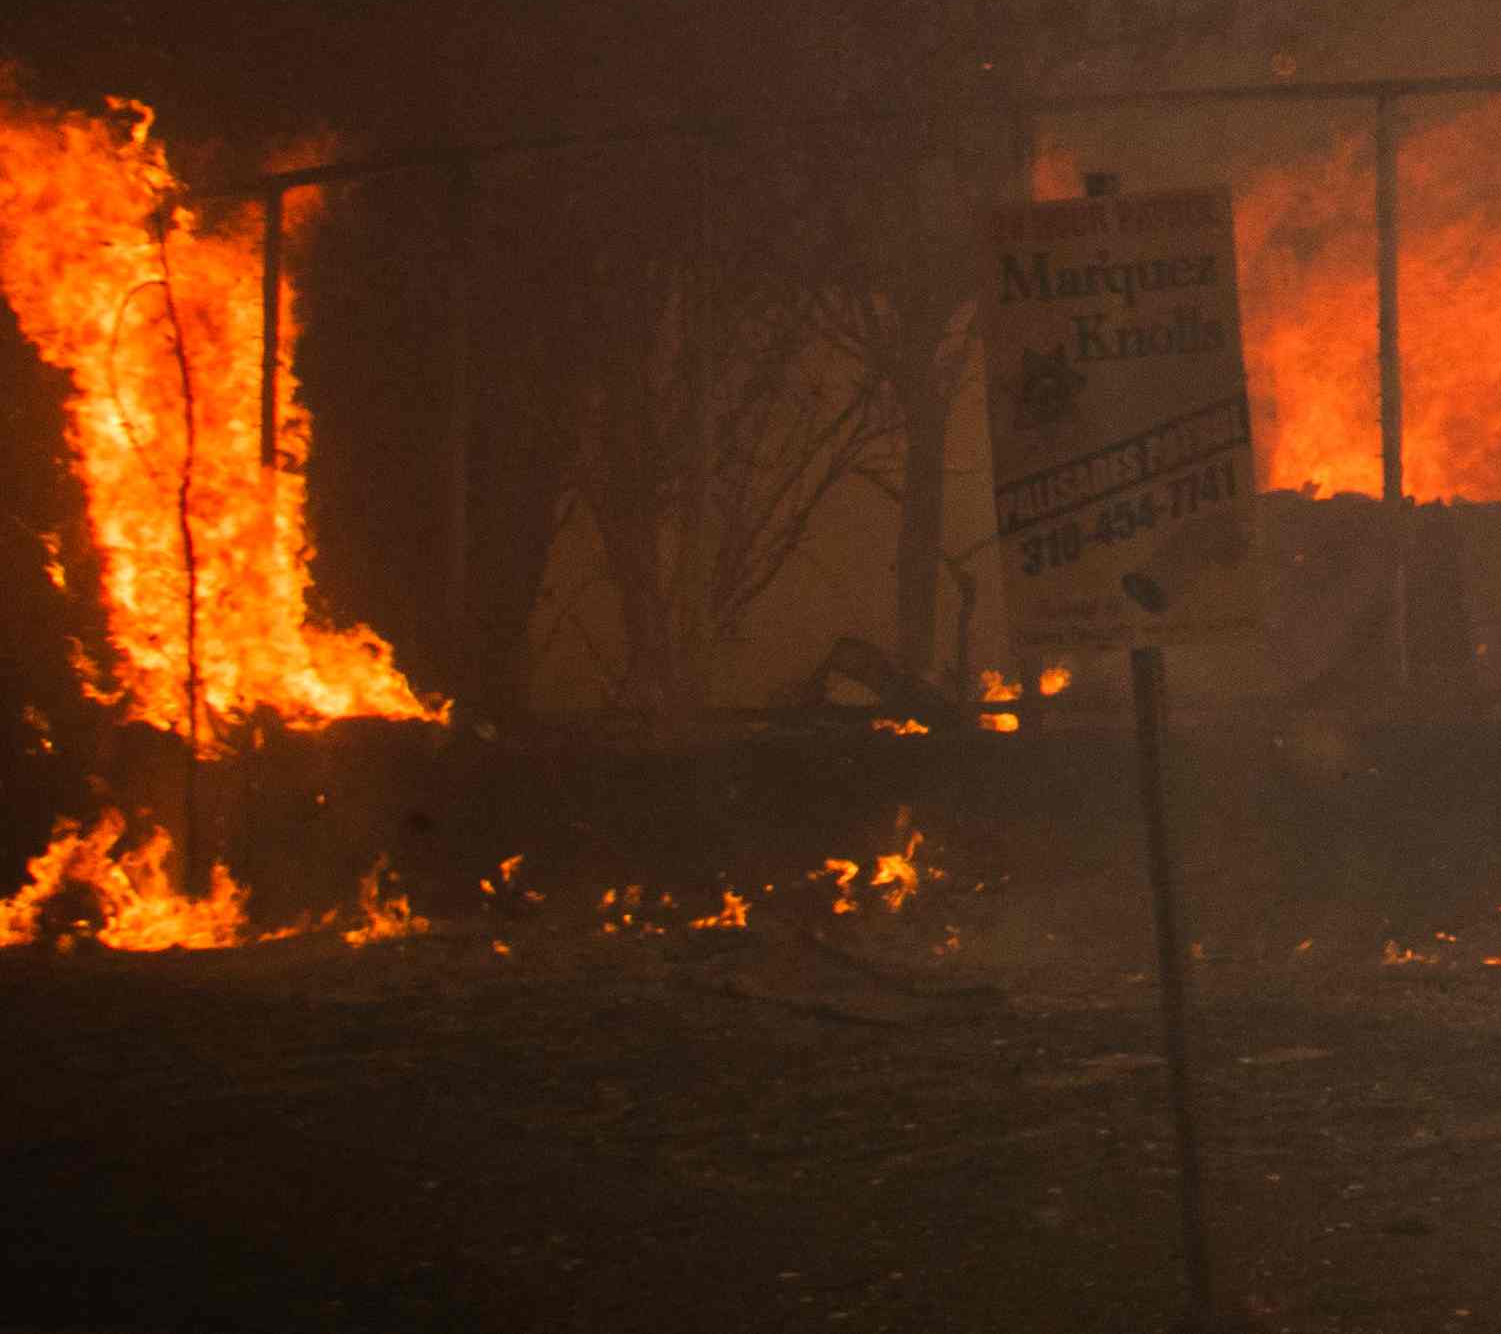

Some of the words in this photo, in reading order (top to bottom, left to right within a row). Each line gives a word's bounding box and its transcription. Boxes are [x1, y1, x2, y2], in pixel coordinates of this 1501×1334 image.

[997, 250, 1219, 308] Marquez
[1069, 305, 1227, 363] Knolls
[996, 444, 1139, 535] PALISADES
[1020, 457, 1237, 577] 310-454-7741
